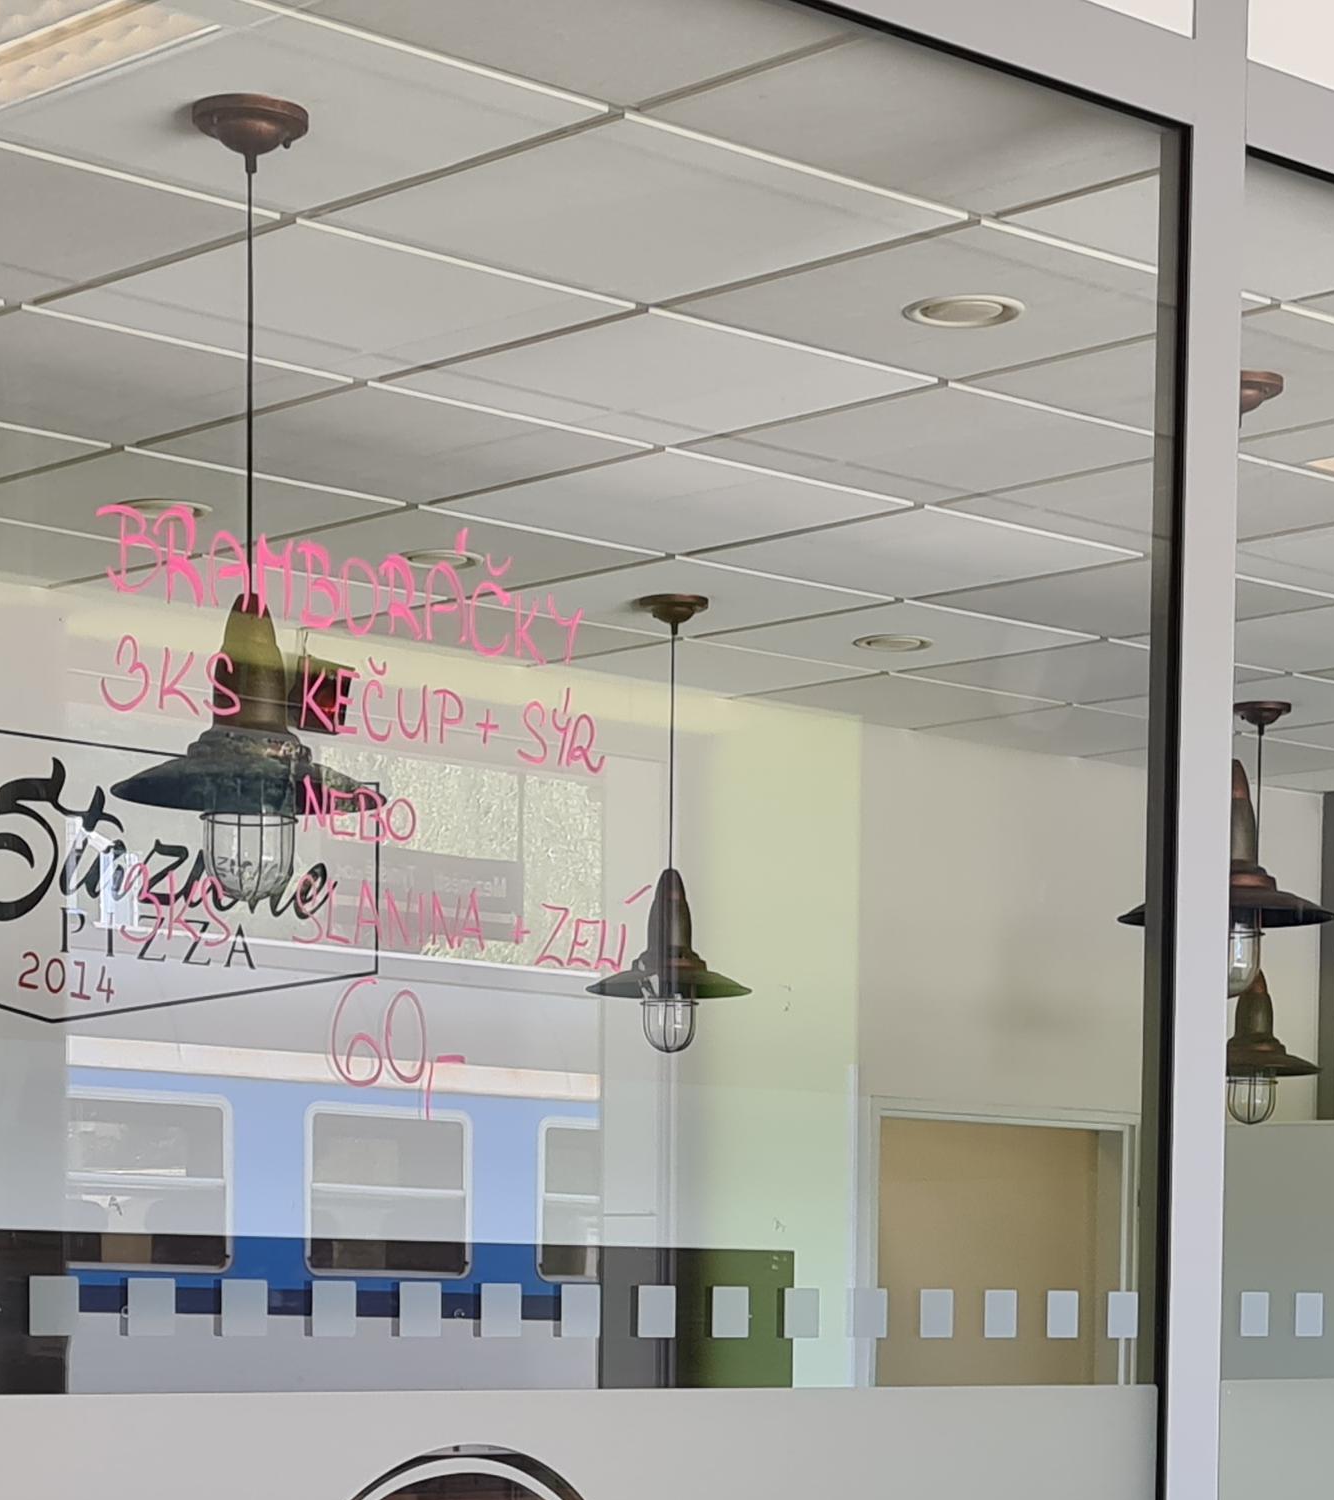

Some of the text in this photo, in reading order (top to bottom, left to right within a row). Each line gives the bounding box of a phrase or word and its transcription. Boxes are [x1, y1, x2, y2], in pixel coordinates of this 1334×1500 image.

[95, 504, 584, 665] BRAMBORÁČKY
[101, 635, 242, 716] 3KS
[299, 655, 465, 745] KEČUP
[517, 686, 606, 775] SÝR
[302, 775, 416, 843] NEBO
[60, 906, 257, 970] PIZZA
[292, 877, 486, 951] SLANINA
[18, 951, 115, 1003] 2014
